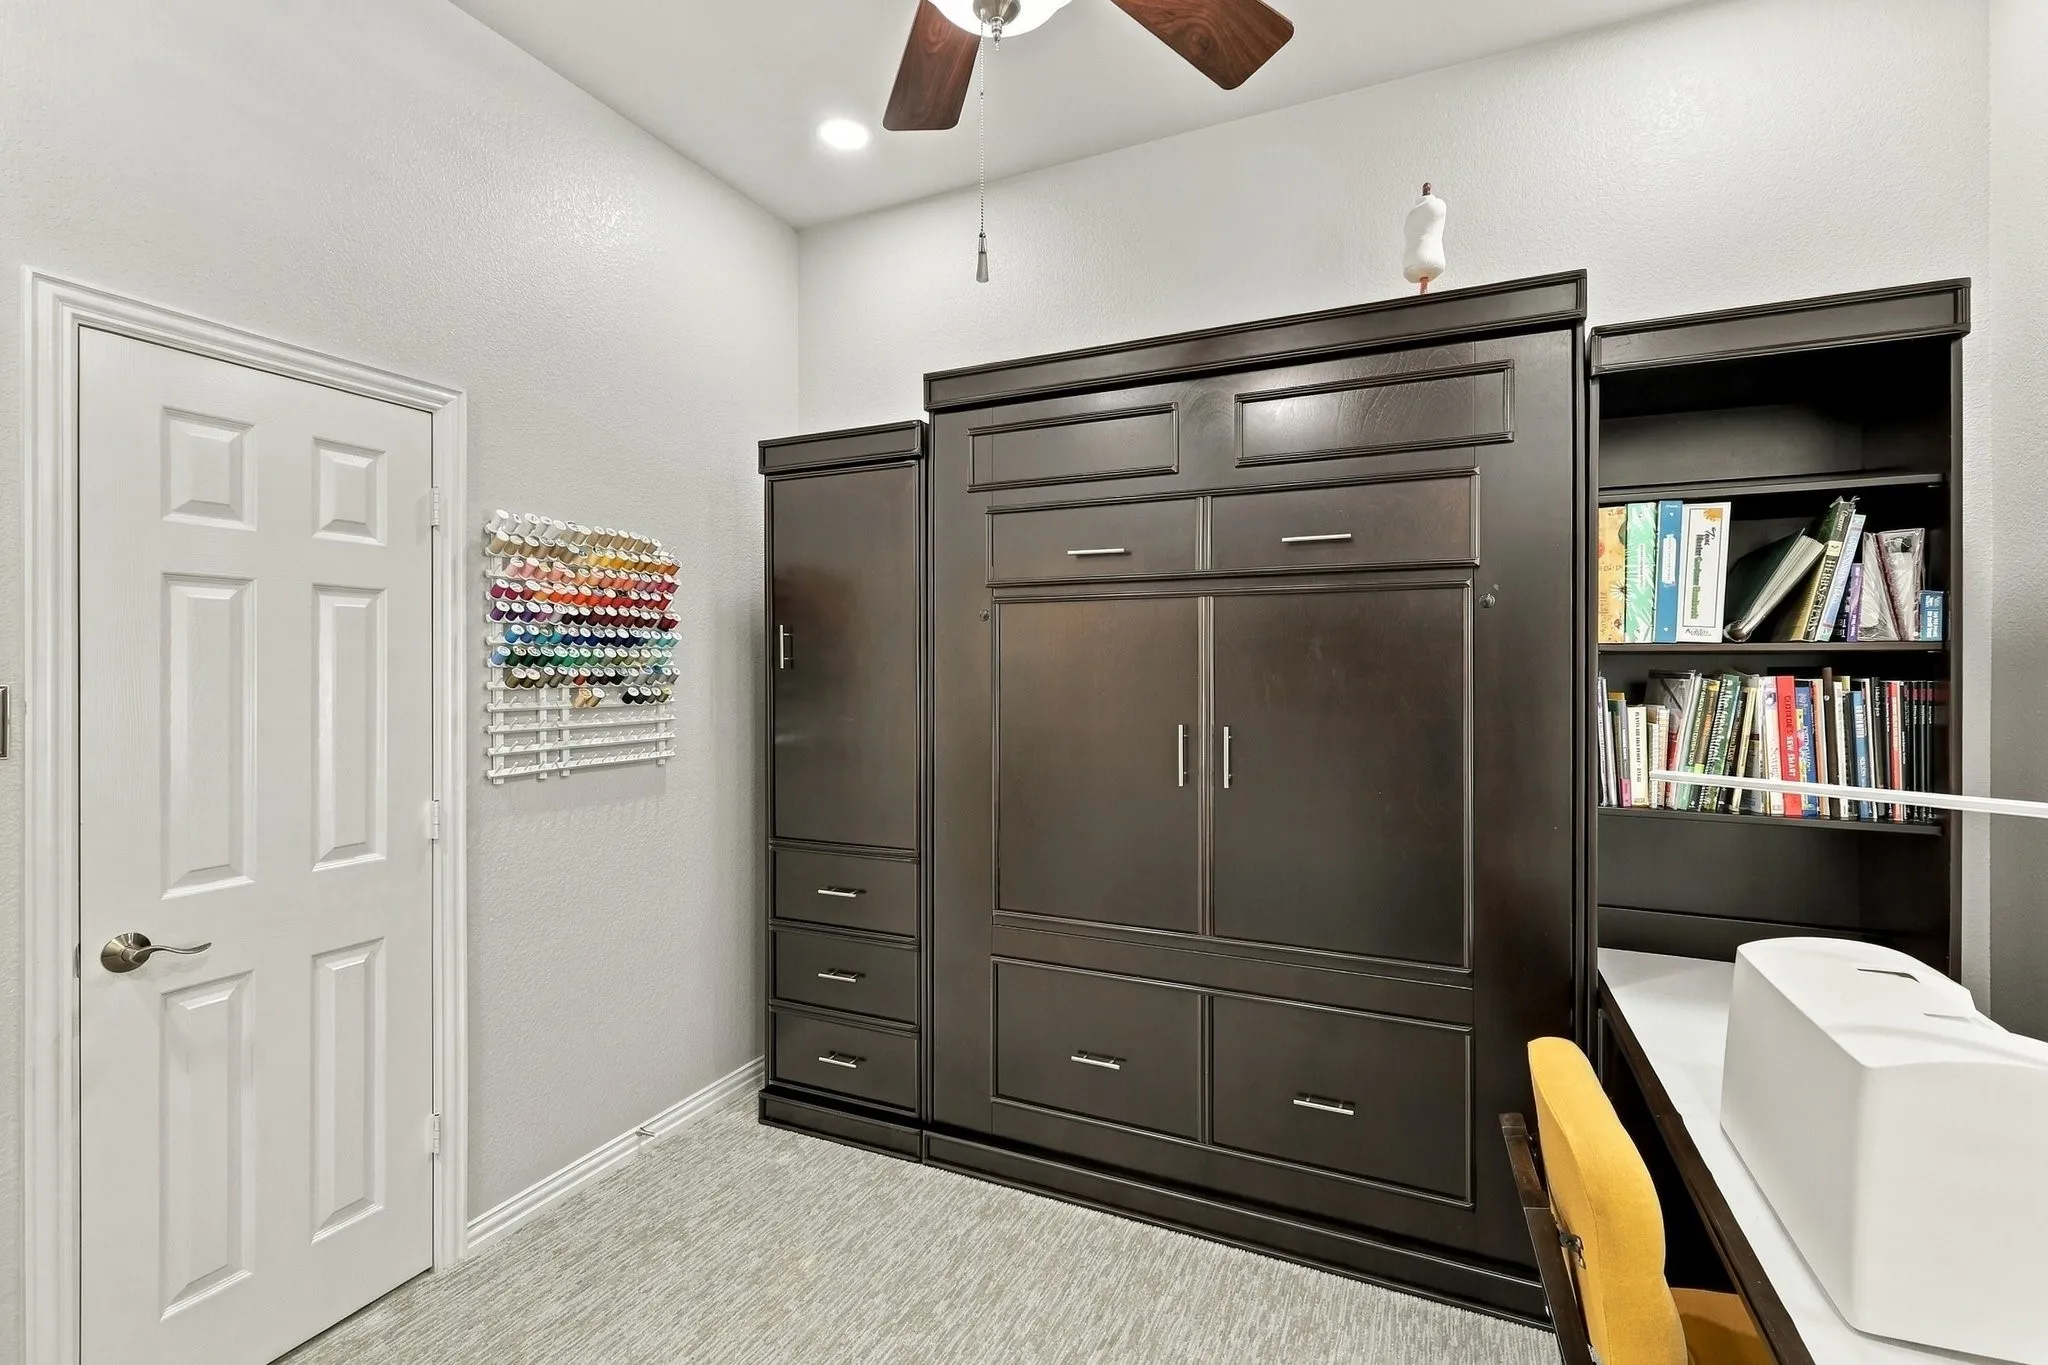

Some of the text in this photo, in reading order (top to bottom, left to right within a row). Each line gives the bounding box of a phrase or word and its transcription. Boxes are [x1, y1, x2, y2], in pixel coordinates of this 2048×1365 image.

[1817, 559, 1835, 594] HERBS
[1786, 735, 1794, 750] SEW
[1786, 753, 1795, 776] SMART
